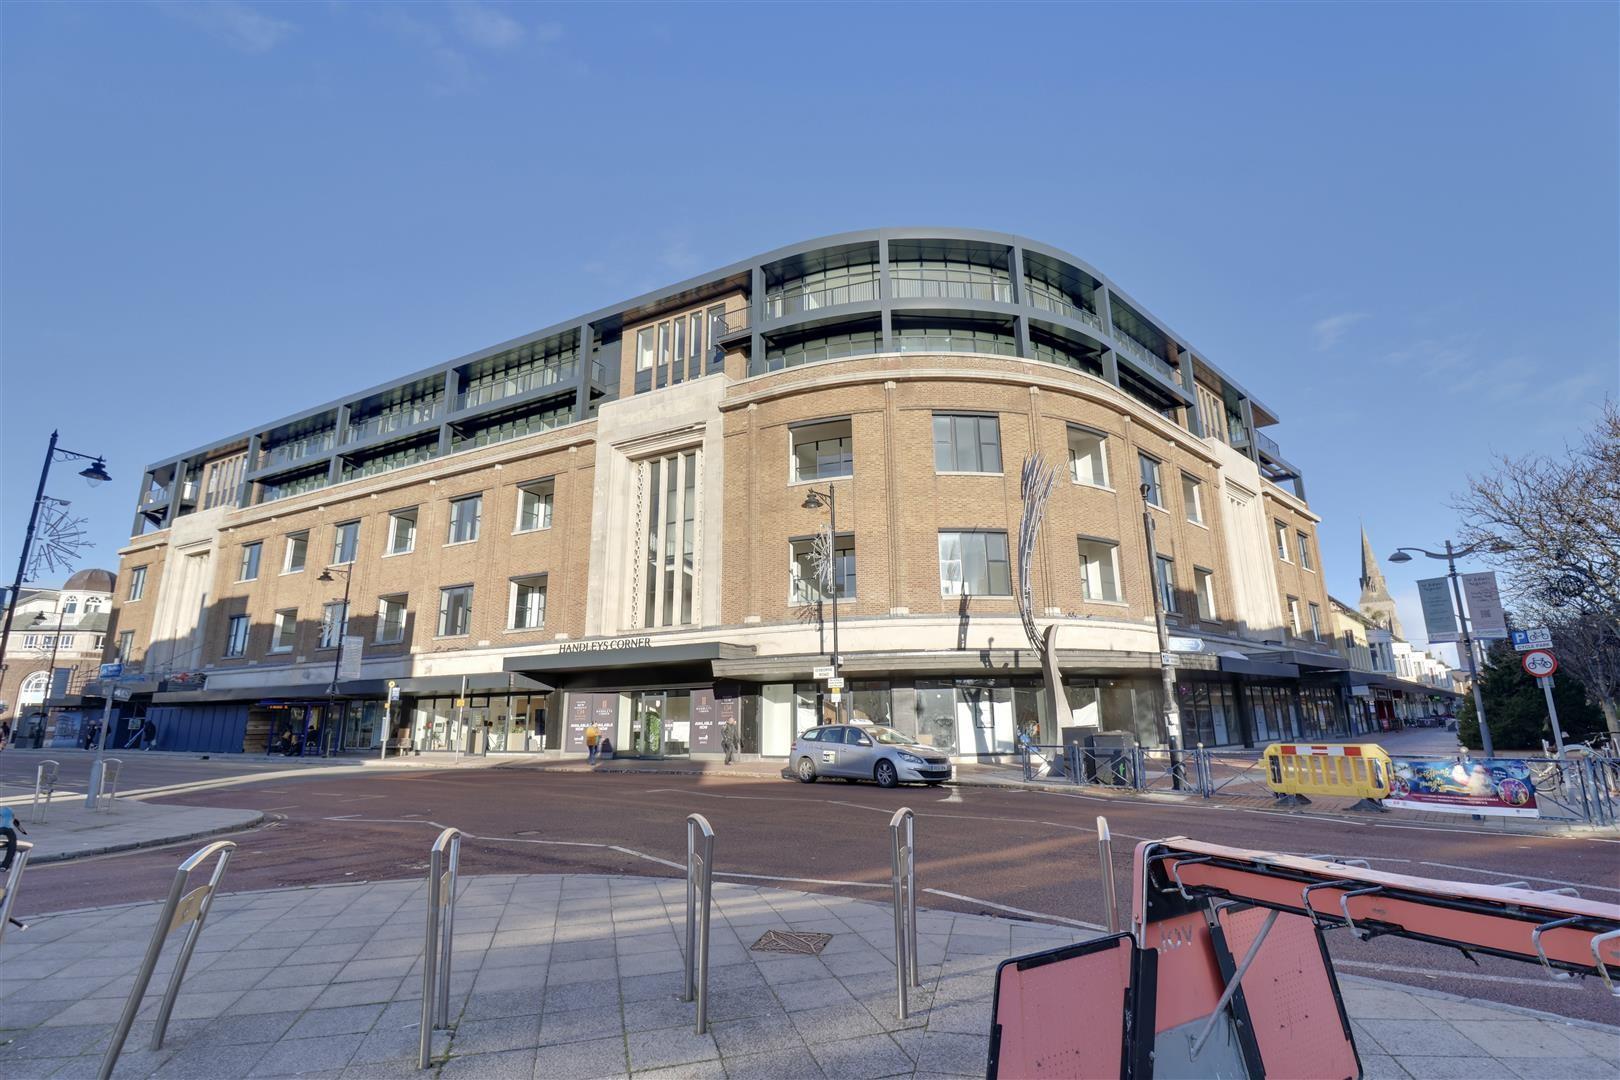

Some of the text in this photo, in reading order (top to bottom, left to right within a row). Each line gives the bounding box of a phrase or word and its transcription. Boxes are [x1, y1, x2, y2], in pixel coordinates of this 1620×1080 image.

[1515, 632, 1525, 643] P
[559, 637, 651, 654] HANDLEYS CORNER
